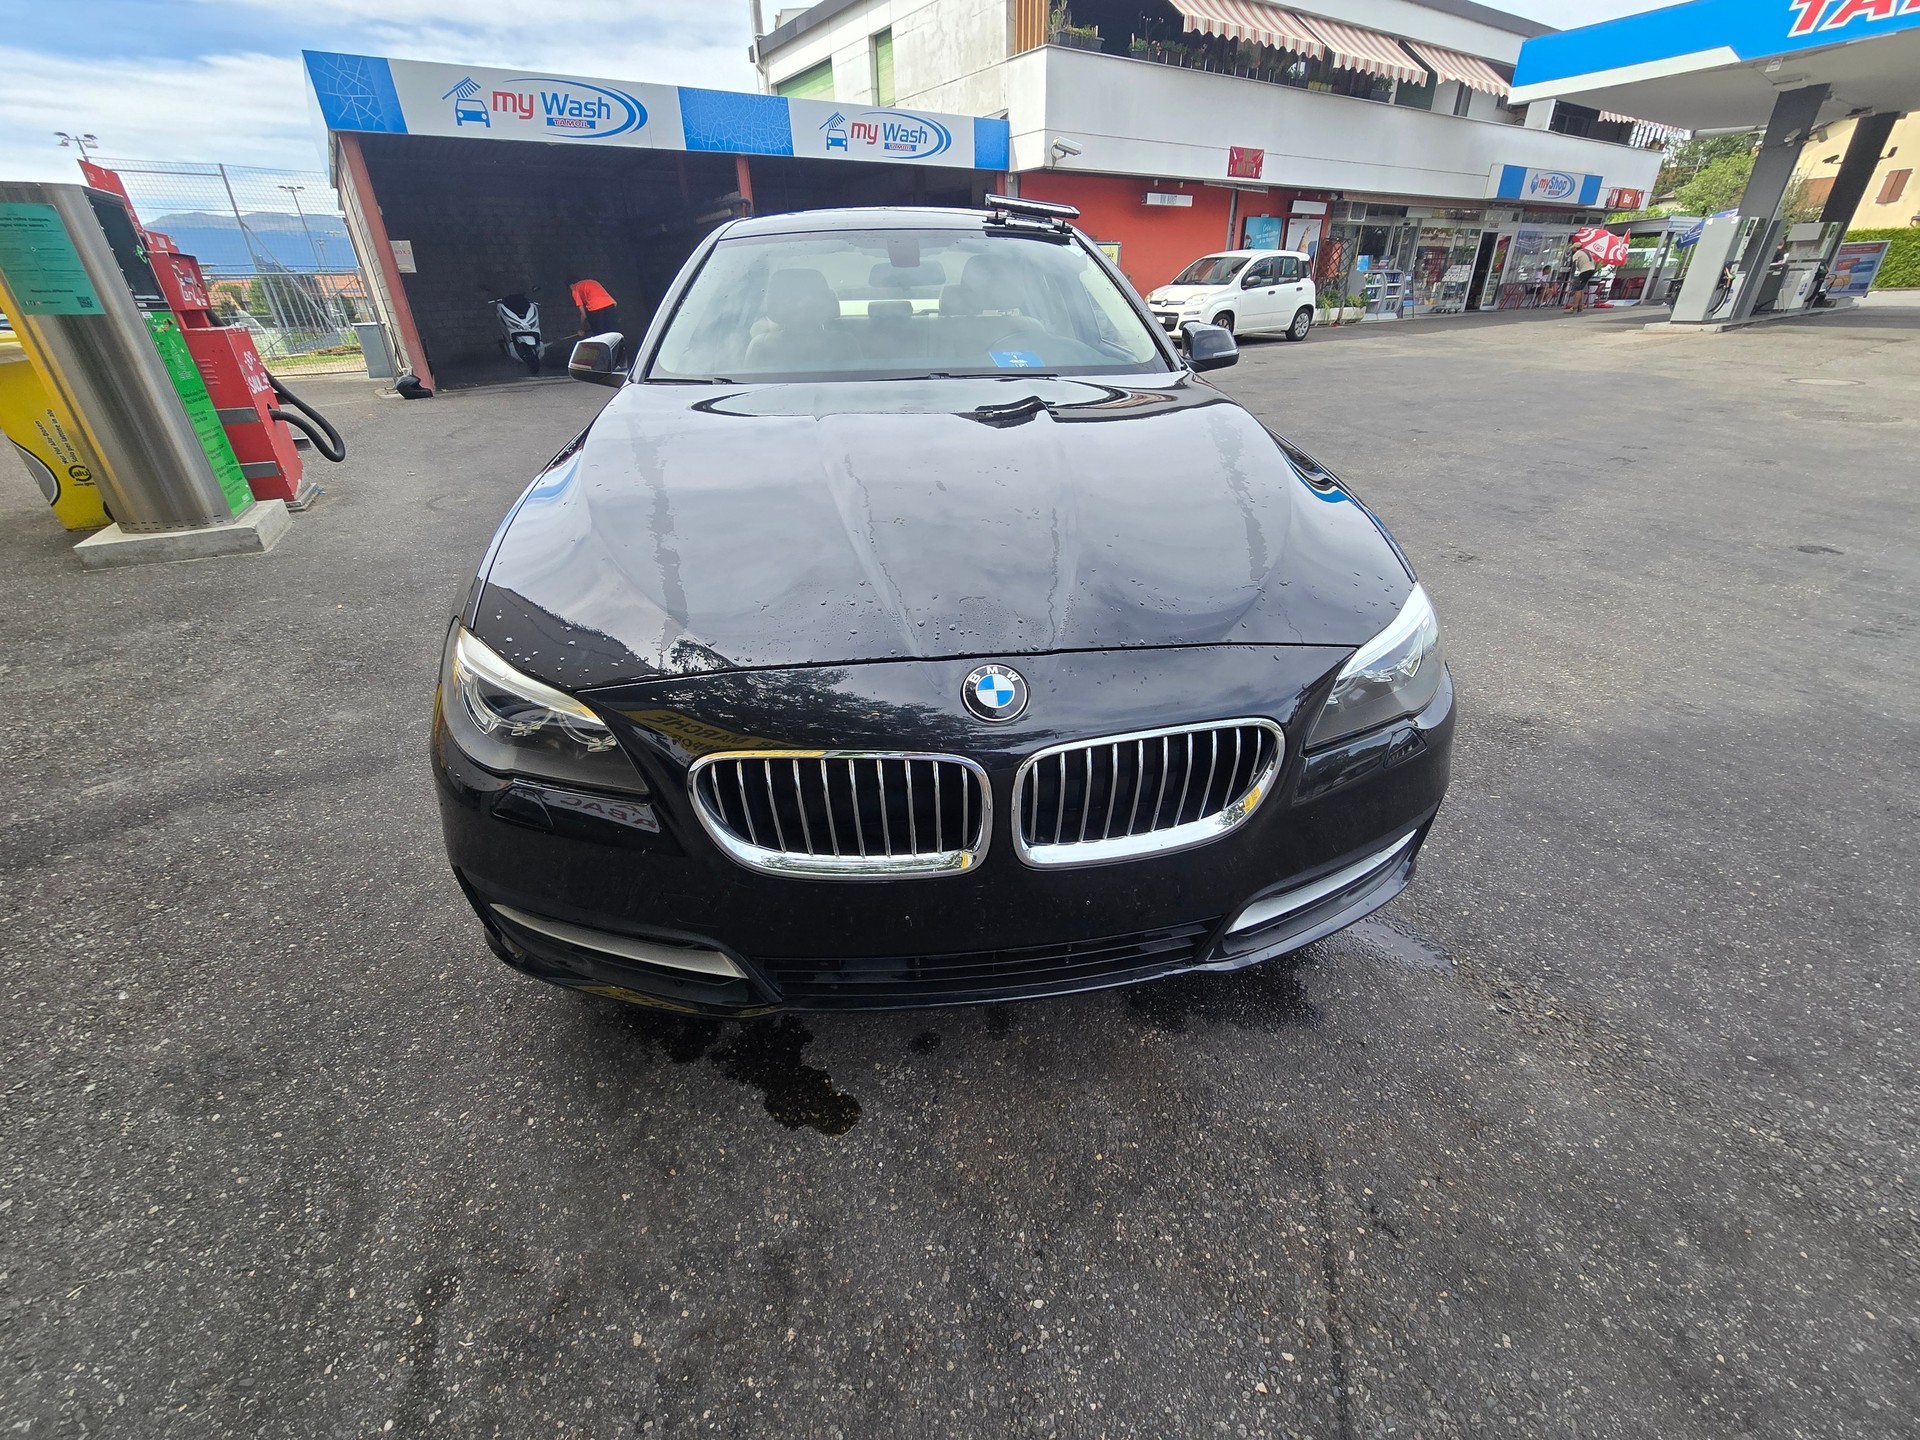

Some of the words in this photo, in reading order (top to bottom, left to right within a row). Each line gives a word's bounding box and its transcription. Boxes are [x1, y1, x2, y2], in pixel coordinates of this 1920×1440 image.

[1787, 0, 1920, 38] TA
[492, 91, 534, 120] my
[540, 91, 611, 120] Wash
[553, 119, 590, 128] TAMOIL
[850, 122, 879, 145] my
[882, 122, 928, 144] Wash
[968, 666, 1021, 684] BMW
